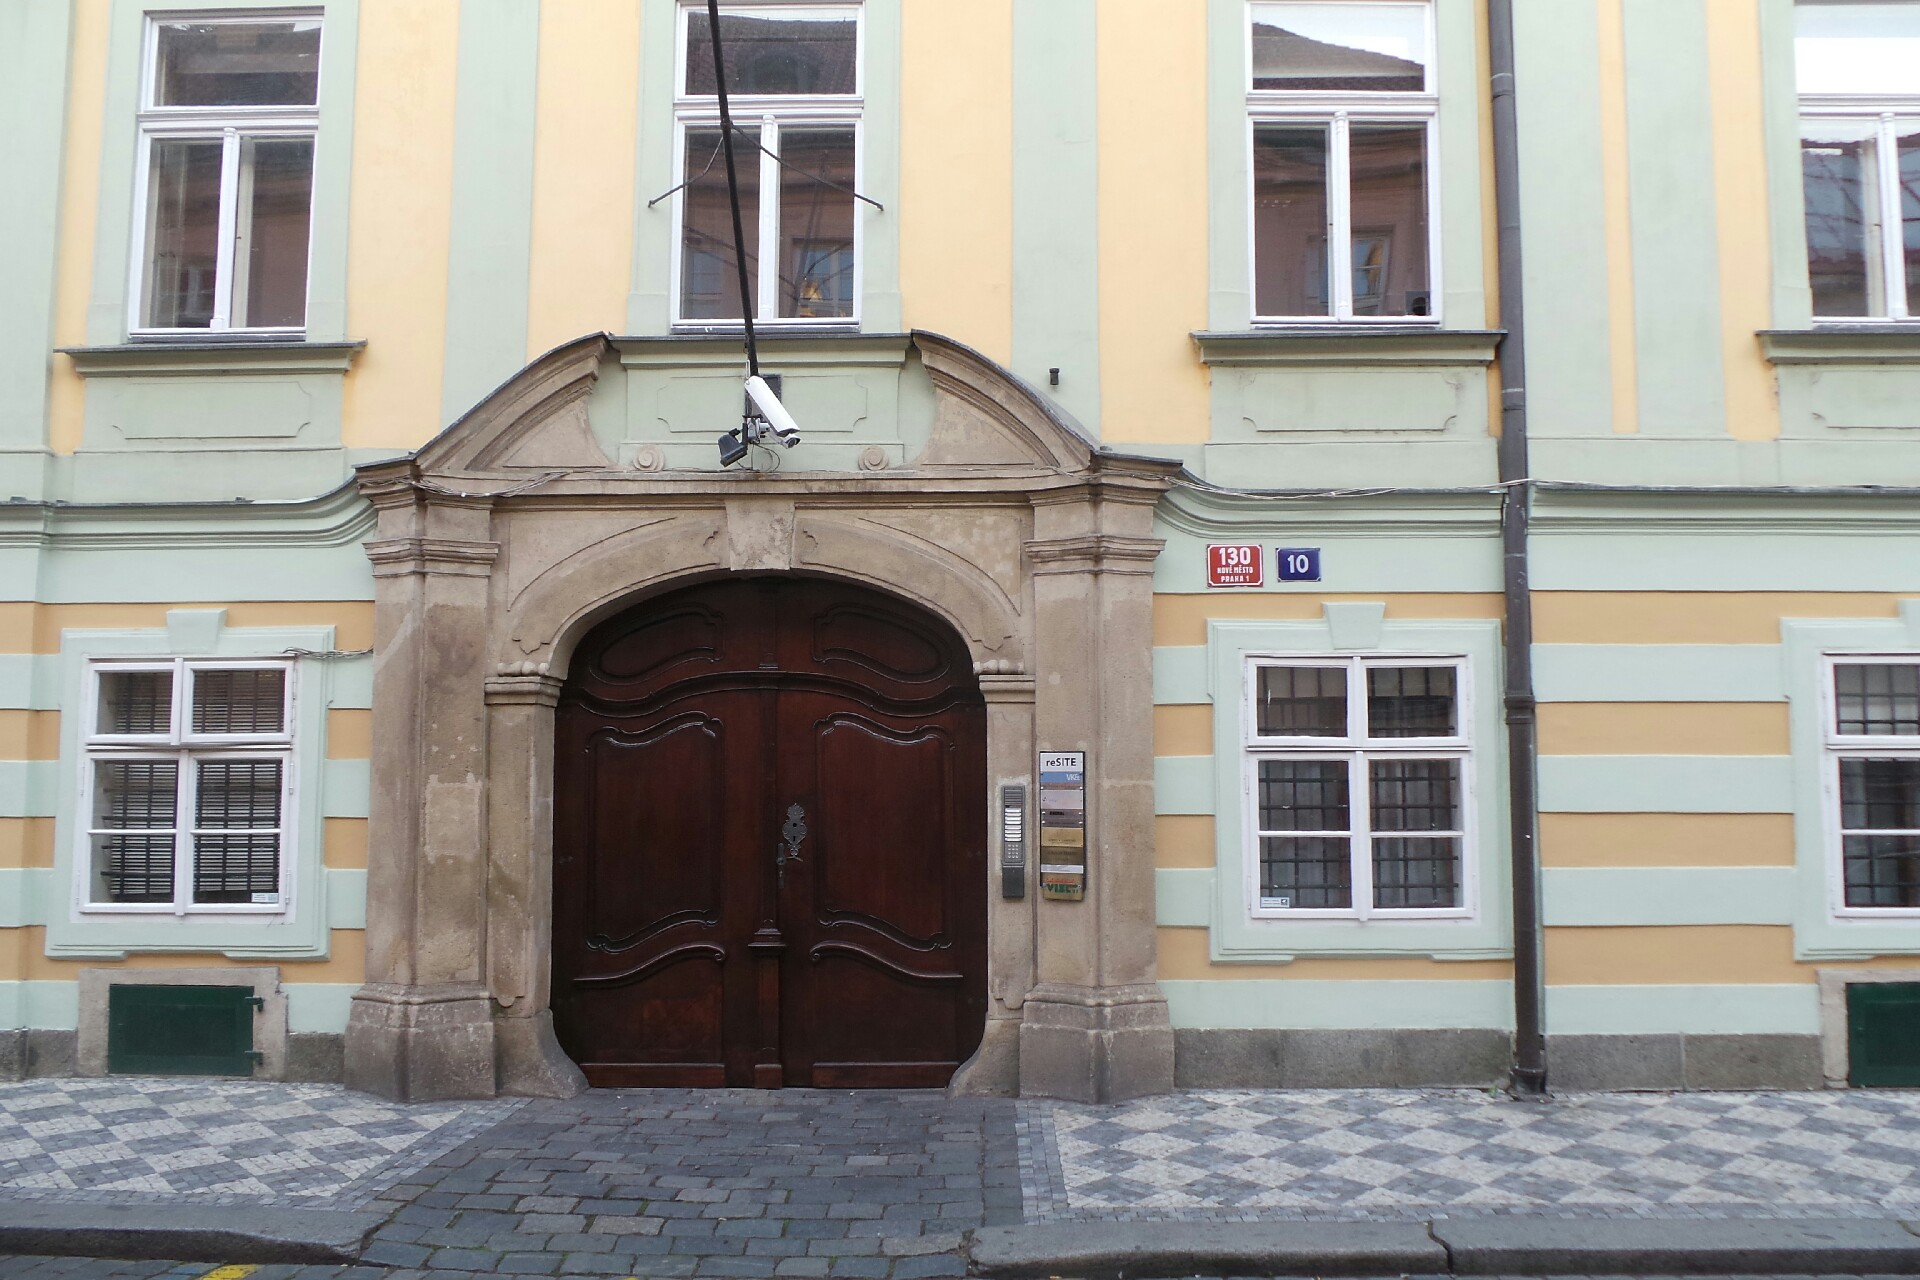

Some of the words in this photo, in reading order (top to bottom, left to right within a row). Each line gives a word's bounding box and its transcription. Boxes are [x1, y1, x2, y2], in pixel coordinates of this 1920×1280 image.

[1219, 547, 1251, 565] 130
[1287, 554, 1309, 574] 10
[1217, 565, 1233, 574] NOVÉ
[1233, 565, 1254, 574] MĚSTO
[1220, 575, 1244, 583] PRAHA
[1046, 757, 1077, 767] reSITE
